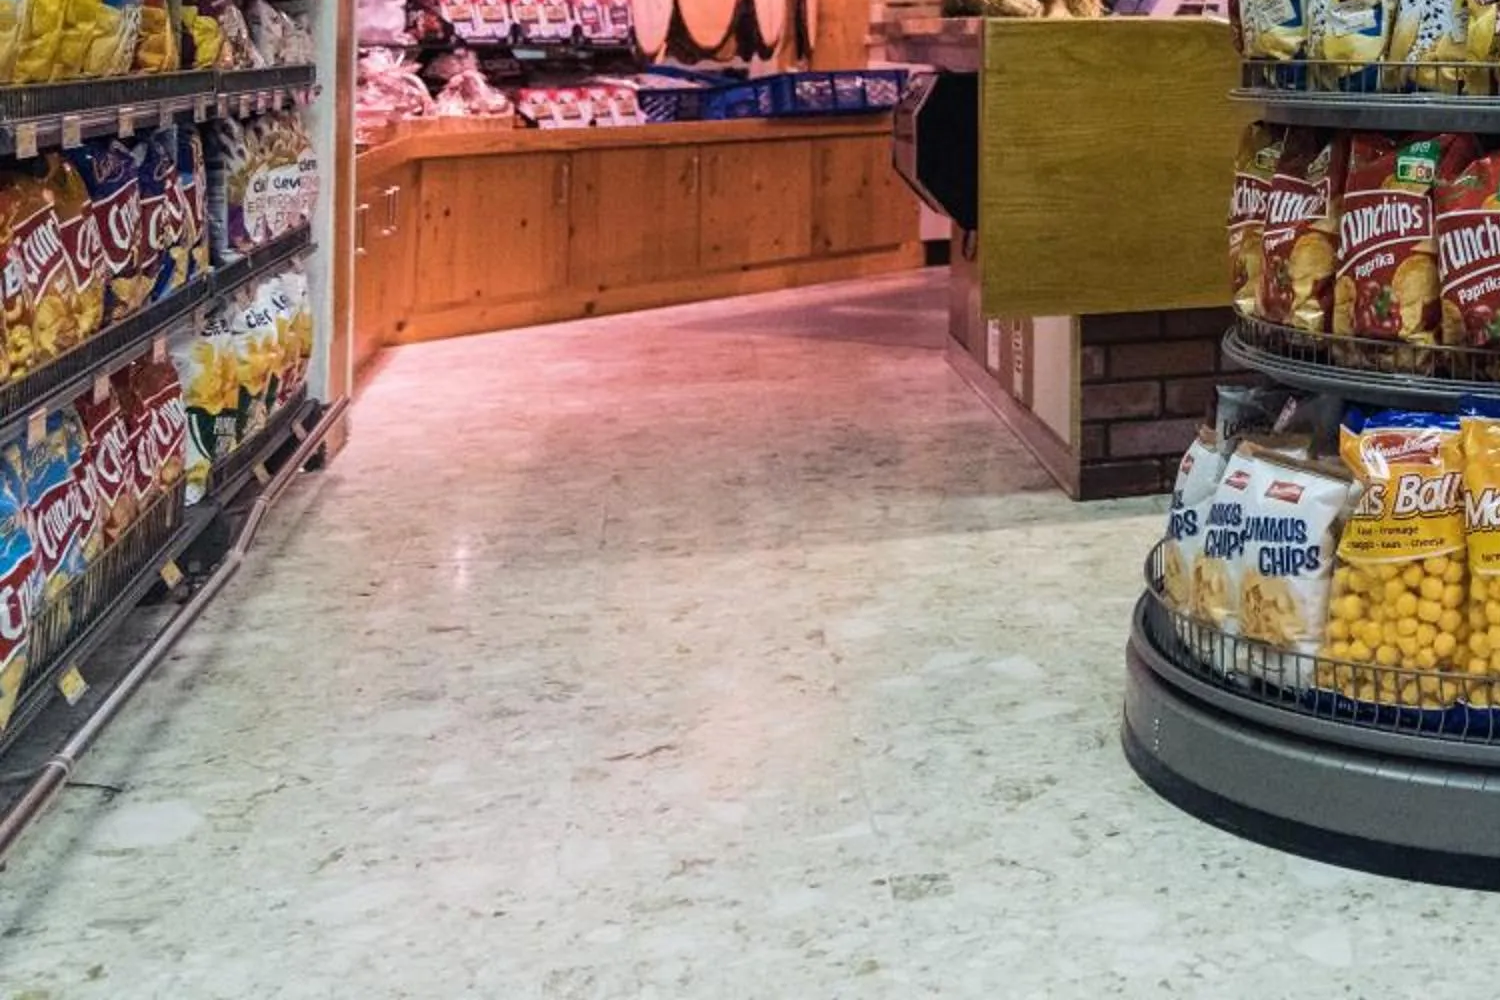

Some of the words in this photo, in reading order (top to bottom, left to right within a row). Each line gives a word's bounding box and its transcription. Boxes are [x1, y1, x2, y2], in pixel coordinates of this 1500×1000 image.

[1338, 195, 1424, 261] runchips
[1393, 473, 1464, 514] Ball
[1245, 515, 1308, 544] UMMUS
[1258, 545, 1321, 577] CHIPS
